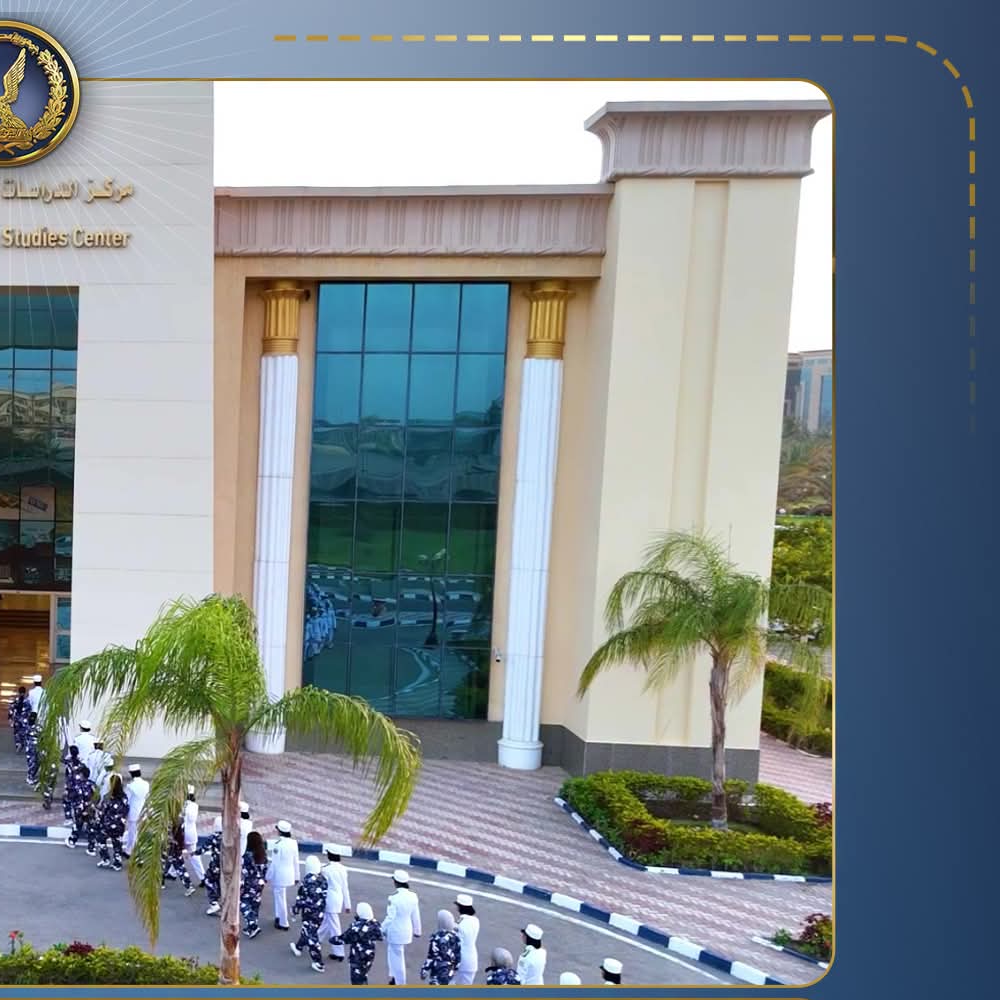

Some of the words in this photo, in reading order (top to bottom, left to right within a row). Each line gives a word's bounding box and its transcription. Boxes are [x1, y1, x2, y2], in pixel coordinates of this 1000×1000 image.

[2, 178, 79, 204] الدراسات
[85, 176, 135, 204] مركز
[2, 226, 68, 248] Studies
[72, 226, 131, 248] Center
